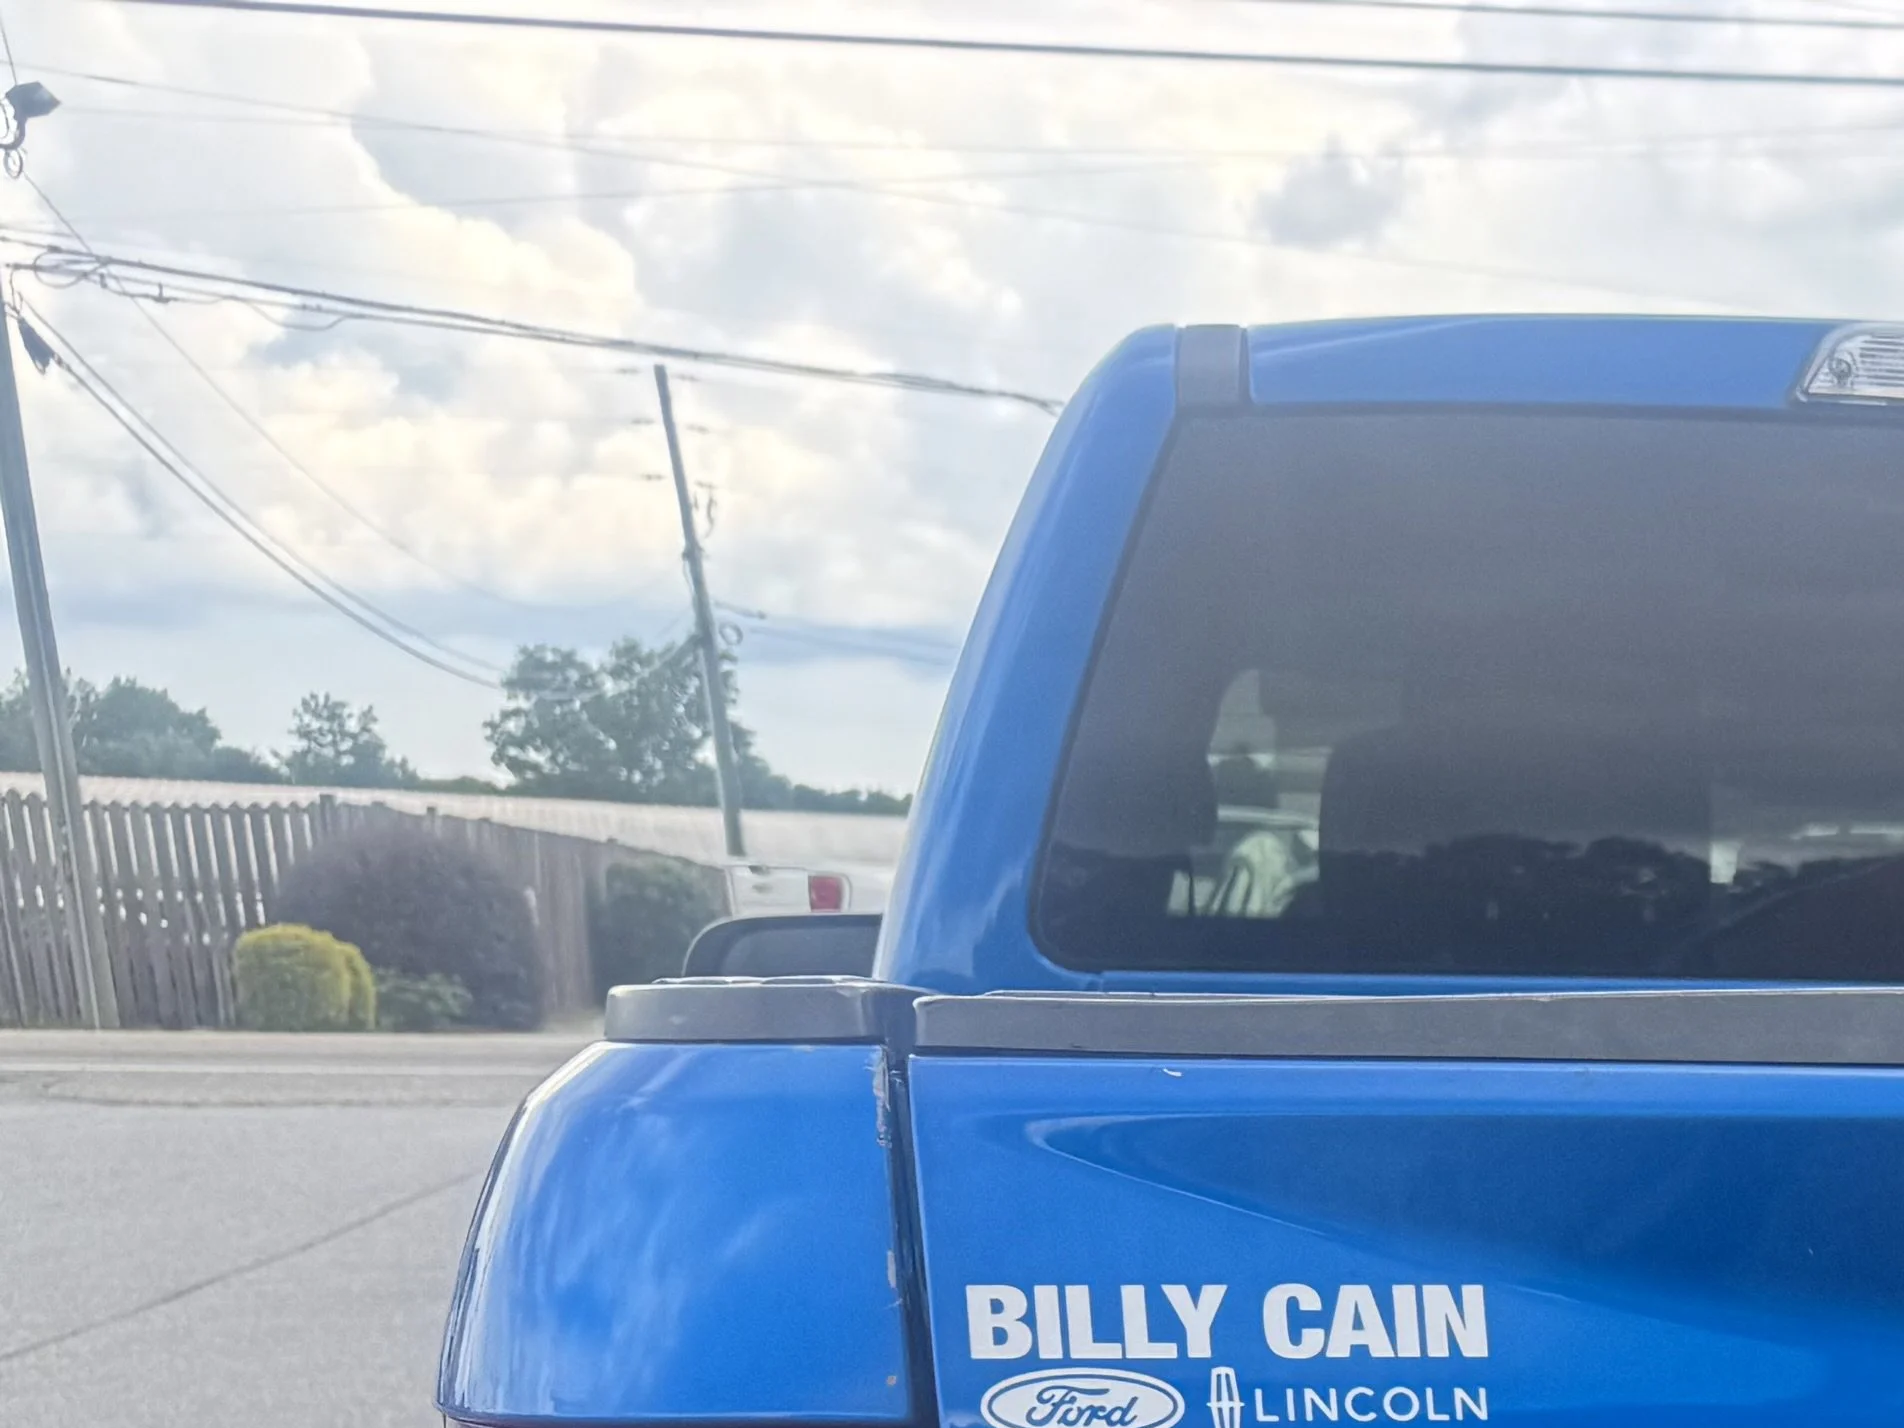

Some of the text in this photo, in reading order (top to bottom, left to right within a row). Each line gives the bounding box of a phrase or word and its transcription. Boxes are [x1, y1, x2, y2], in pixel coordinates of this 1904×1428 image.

[965, 1282, 1489, 1360] BILLY CAIN
[1024, 1384, 1489, 1428] Ford LINCOLN
